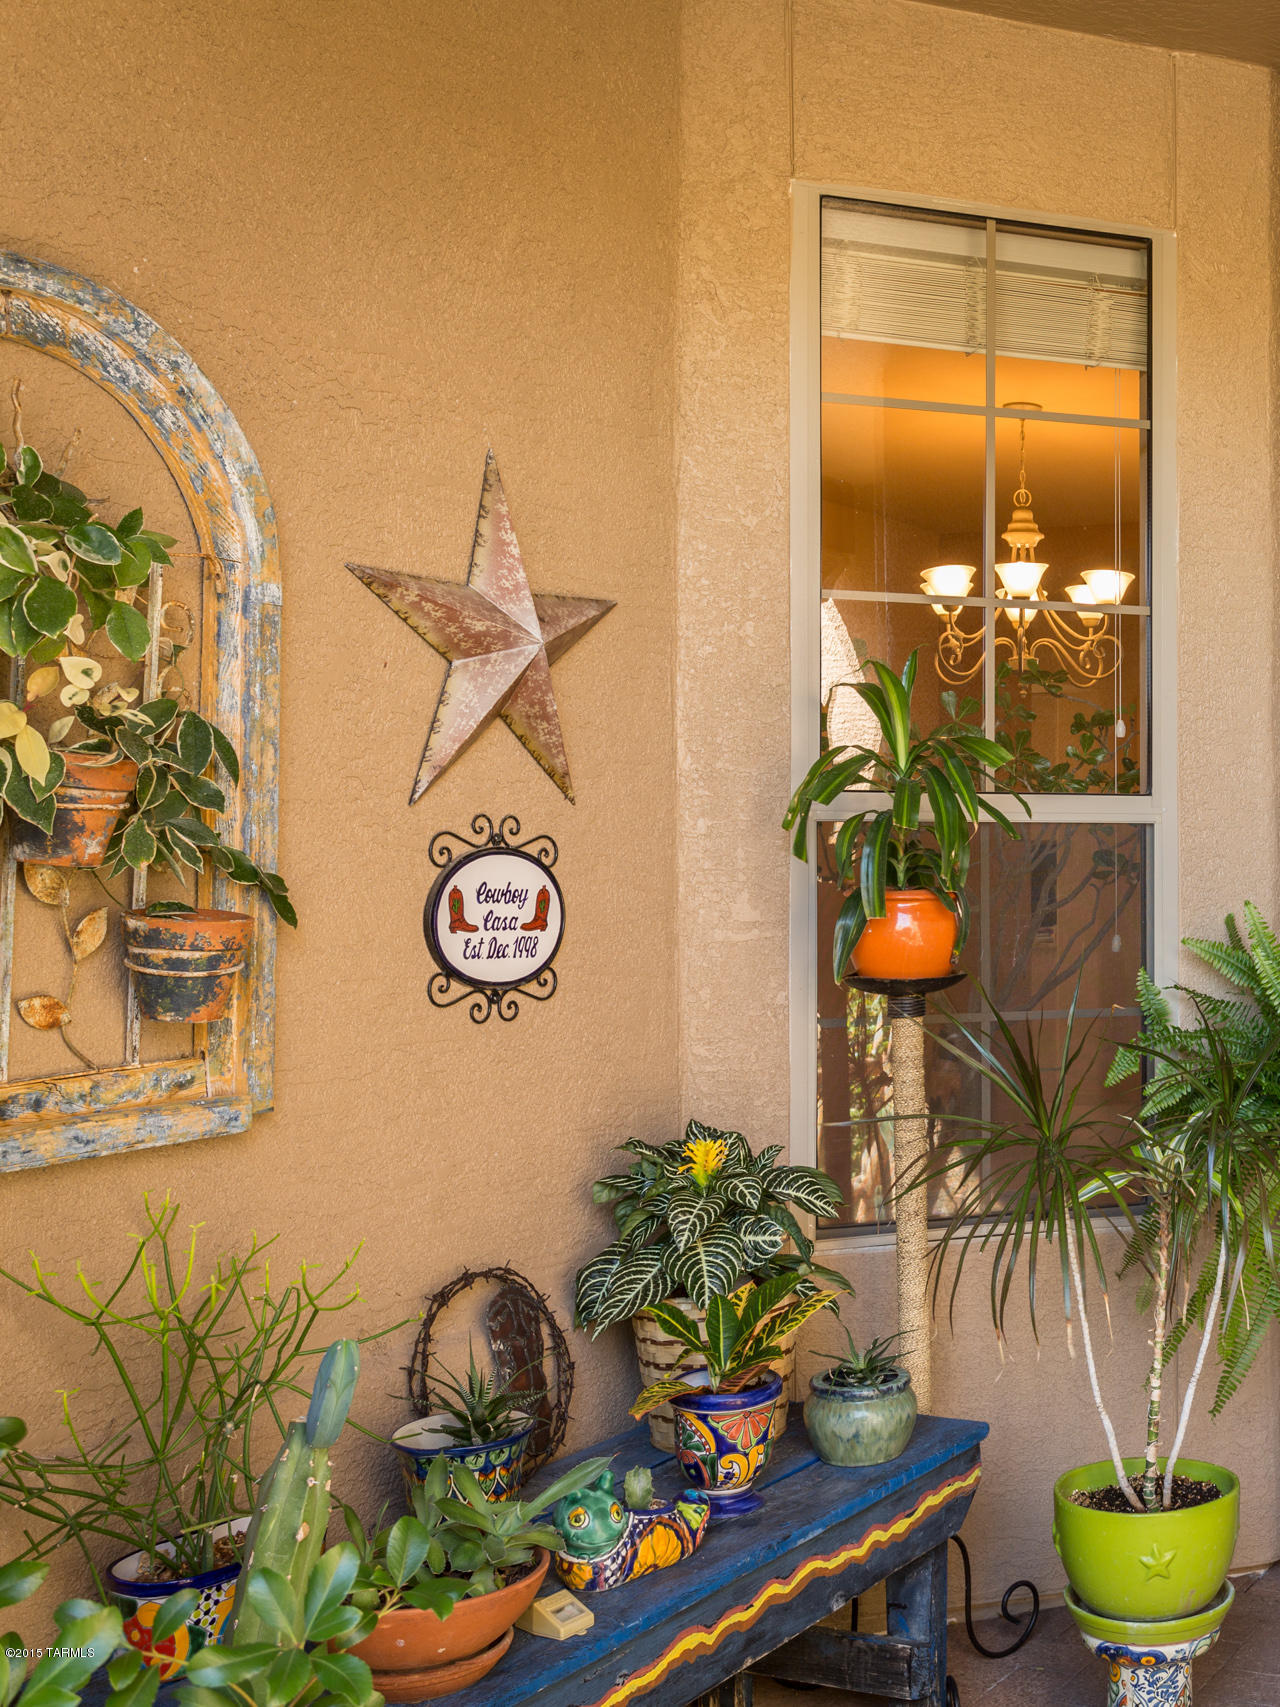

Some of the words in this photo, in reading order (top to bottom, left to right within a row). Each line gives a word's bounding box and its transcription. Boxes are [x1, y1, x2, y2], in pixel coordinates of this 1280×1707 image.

[476, 881, 529, 910] Cowboy
[483, 910, 519, 931] Casa
[512, 935, 539, 959] 1998
